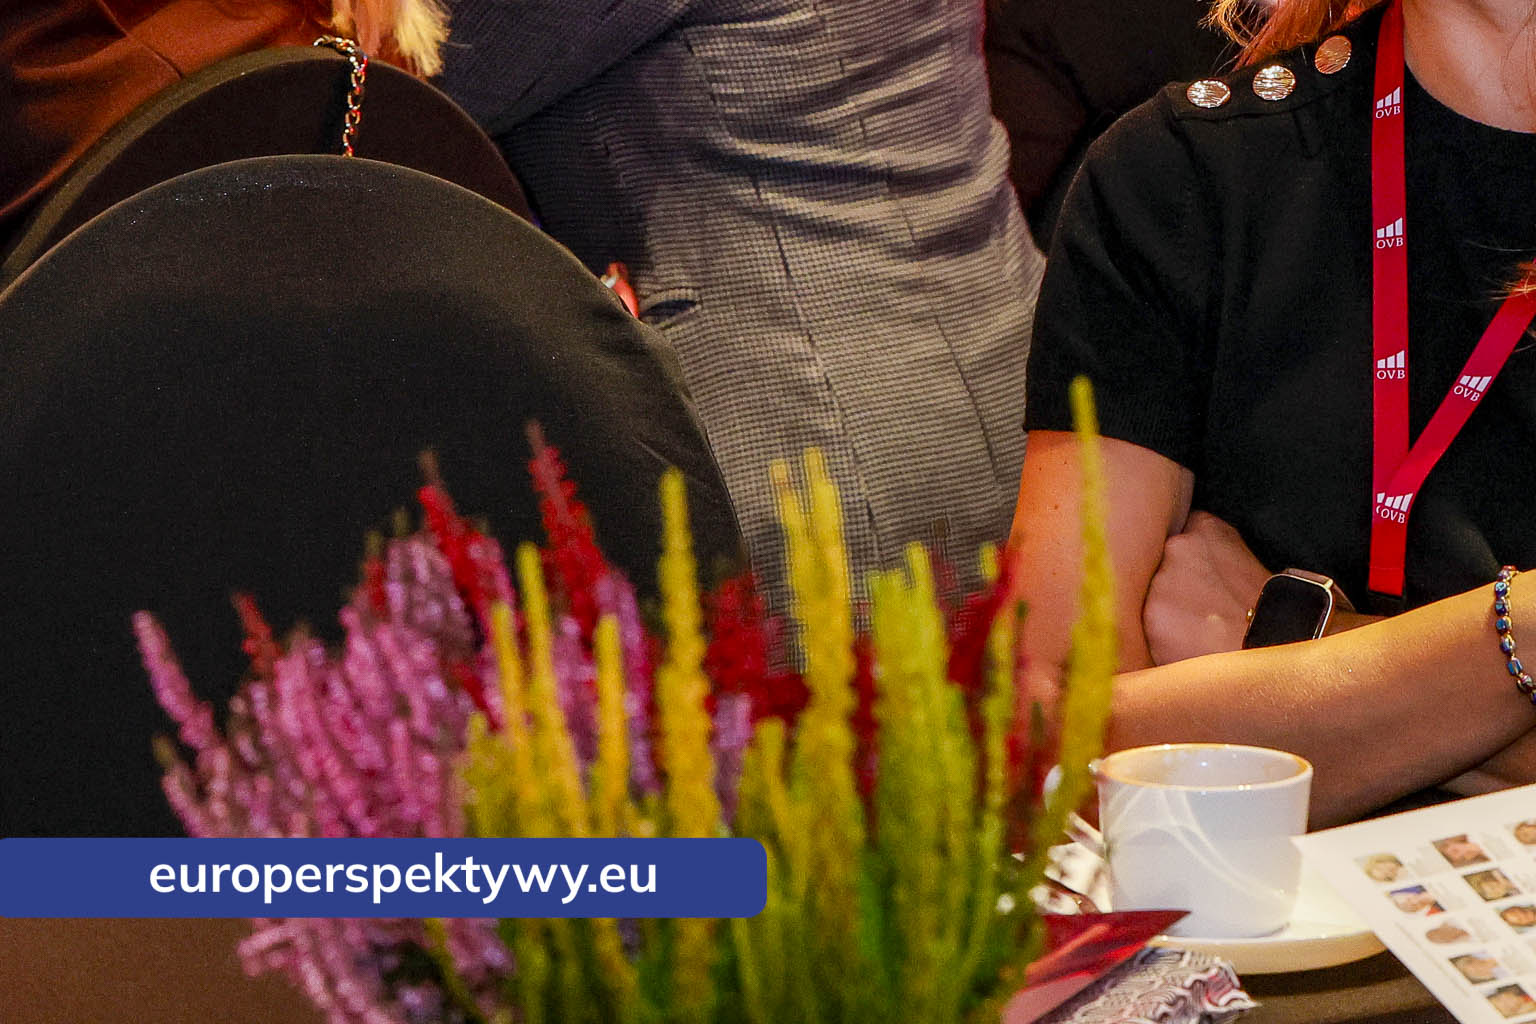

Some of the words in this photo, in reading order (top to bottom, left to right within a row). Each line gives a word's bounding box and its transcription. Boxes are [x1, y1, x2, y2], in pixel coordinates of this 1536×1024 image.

[1375, 105, 1401, 119] OVB
[1376, 237, 1404, 249] OVB
[1376, 369, 1406, 380] OVB
[1453, 385, 1481, 402] OVB
[1380, 508, 1406, 524] OVB
